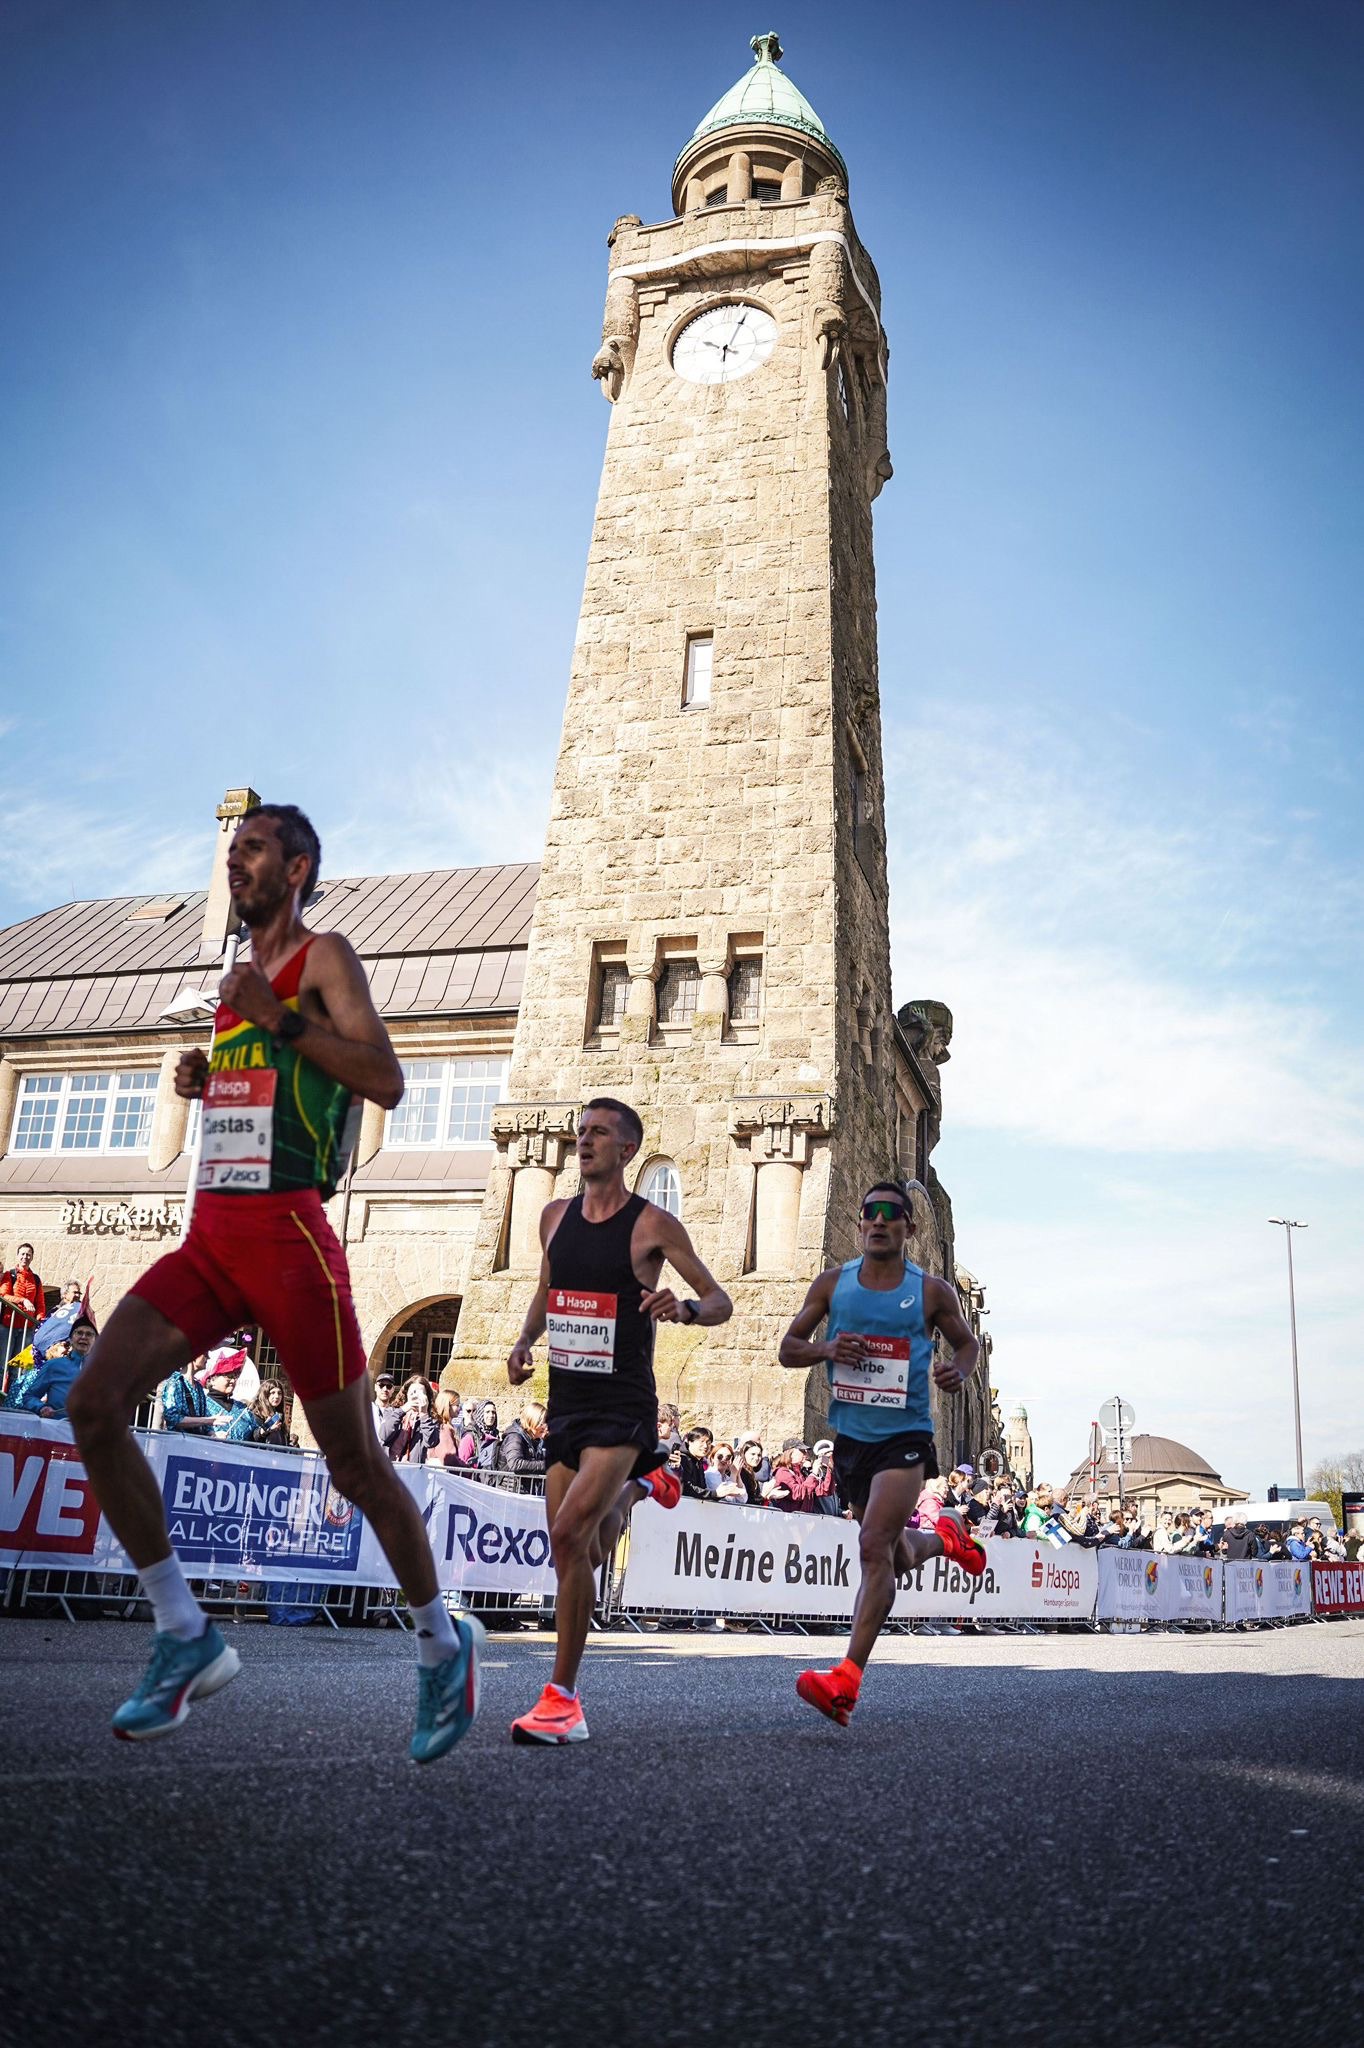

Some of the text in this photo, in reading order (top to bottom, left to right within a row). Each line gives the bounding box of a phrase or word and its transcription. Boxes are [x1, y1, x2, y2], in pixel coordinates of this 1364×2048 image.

[258, 1133, 266, 1145] 0
[232, 1170, 261, 1182] asics
[60, 1205, 184, 1226] BLOCKBRA
[566, 1296, 598, 1311] Haspa
[548, 1319, 608, 1336] Buchanan
[584, 1358, 607, 1369] asics
[853, 1360, 885, 1374] Arbe
[898, 1374, 904, 1383] 0
[839, 1389, 863, 1401] REWE
[880, 1395, 901, 1405] asics
[172, 1470, 323, 1526] ERDINGER
[168, 1519, 352, 1551] ALKOHOLFREI
[445, 1504, 555, 1568] Rexo
[674, 1531, 774, 1583] Meine
[785, 1543, 851, 1587] Bank
[933, 1556, 1000, 1604] Haspa.
[1114, 1556, 1142, 1572] MERKUR
[1046, 1562, 1080, 1596] Haspa
[1118, 1572, 1142, 1588] DRUCK
[1315, 1570, 1345, 1605] REWE
